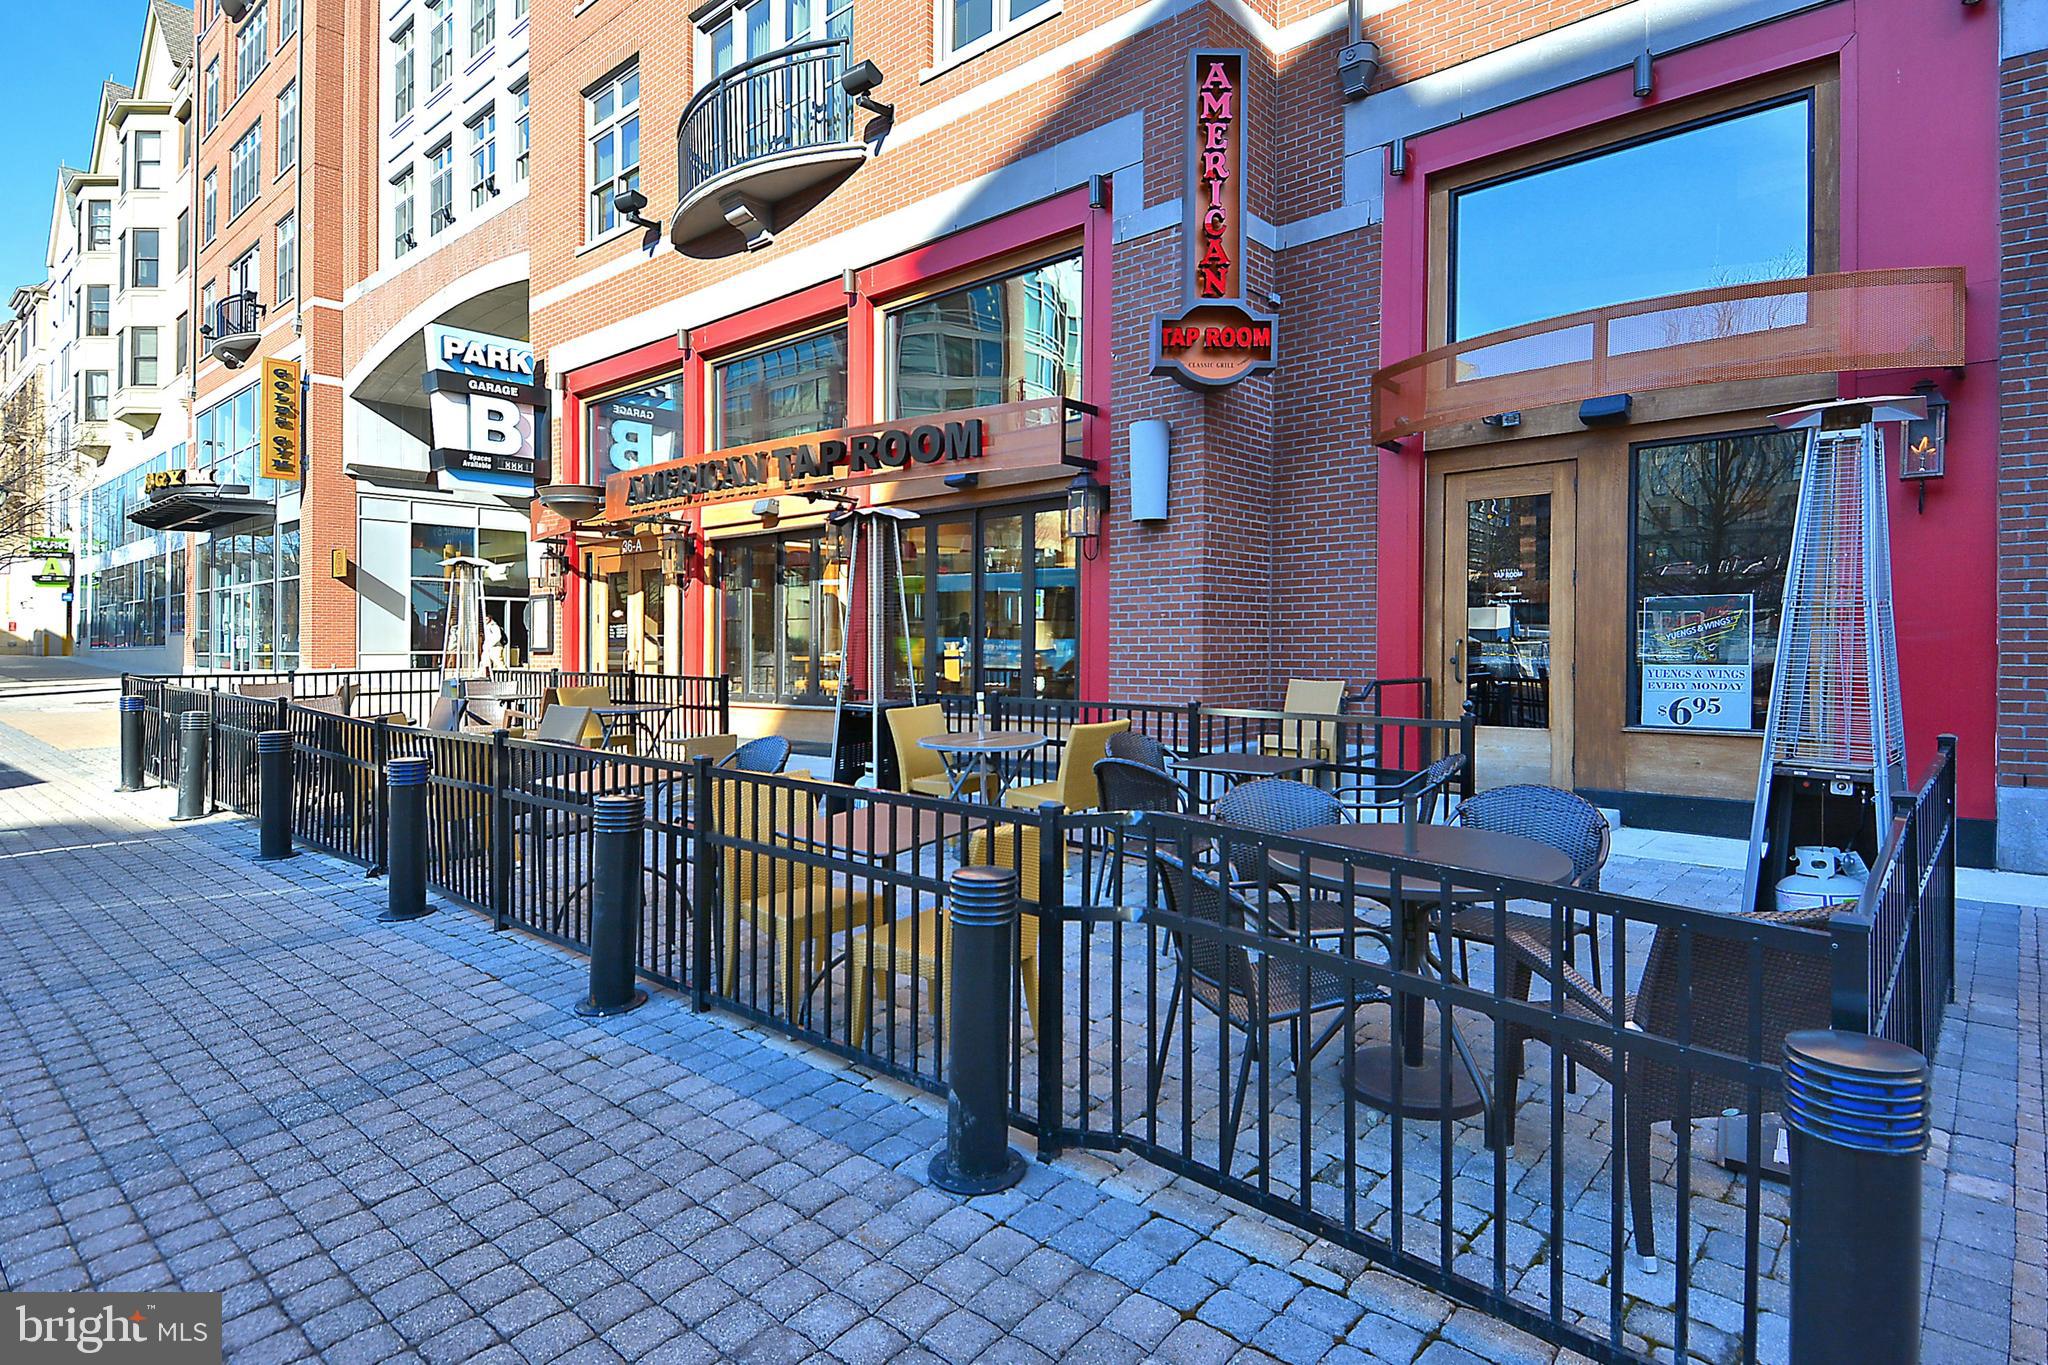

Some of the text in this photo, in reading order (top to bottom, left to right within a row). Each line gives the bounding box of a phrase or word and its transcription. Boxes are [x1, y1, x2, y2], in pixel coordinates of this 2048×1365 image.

[1200, 62, 1233, 297] AMERICAN
[1162, 327, 1270, 347] TAP ROOM
[441, 334, 534, 375] PARK
[468, 379, 519, 397] GARAGE
[469, 393, 524, 456] B
[462, 459, 492, 470] Available
[468, 453, 492, 463] Spaces
[625, 418, 983, 507] AMERICAN TAP ROOM
[621, 539, 643, 553] 36-A
[1665, 625, 1697, 641] YUENGS
[1697, 624, 1704, 632] &
[1704, 616, 1731, 630] WINGS
[1647, 669, 1746, 679] YUENGS & WINGS
[1647, 681, 1744, 691] EVERY MONDAY
